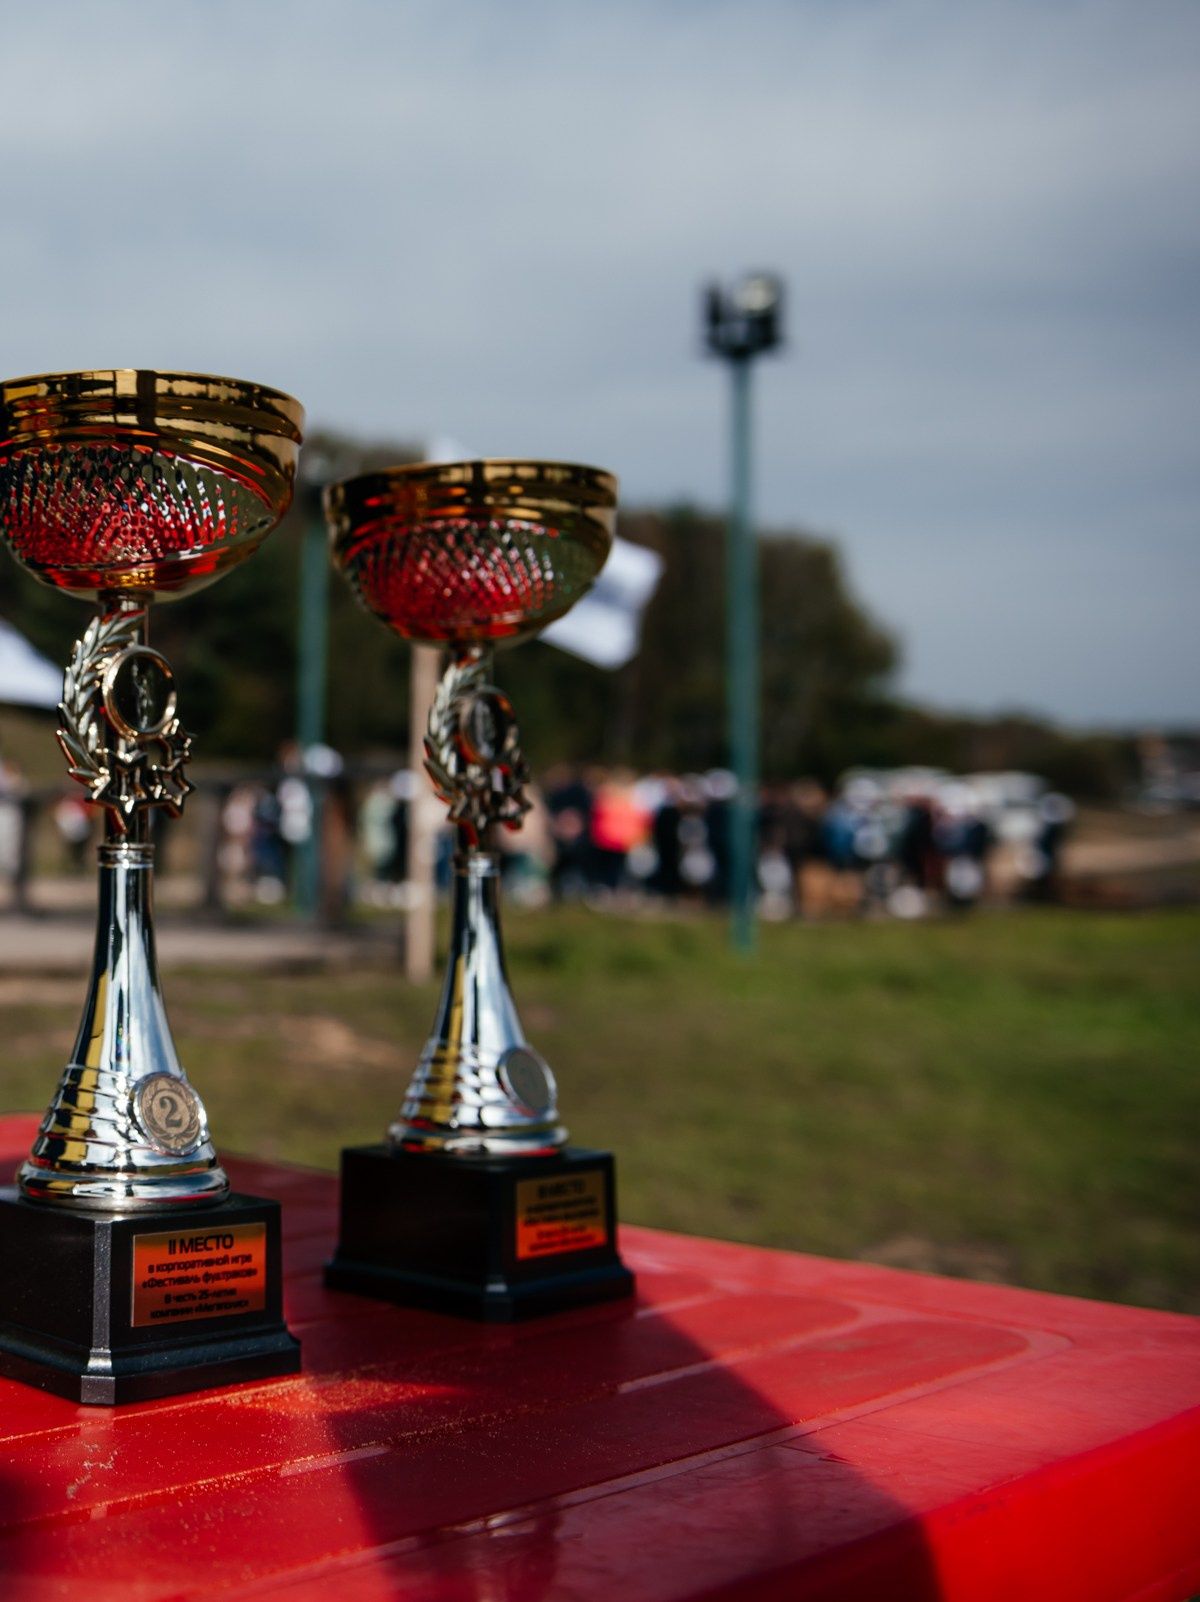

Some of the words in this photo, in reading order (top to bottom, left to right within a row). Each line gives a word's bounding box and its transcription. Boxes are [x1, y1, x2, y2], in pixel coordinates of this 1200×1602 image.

[159, 1096, 182, 1128] 2
[168, 1239, 176, 1255] II
[179, 1234, 234, 1254] МЕСТО
[156, 1255, 230, 1273] корпоративной
[231, 1254, 252, 1265] игре
